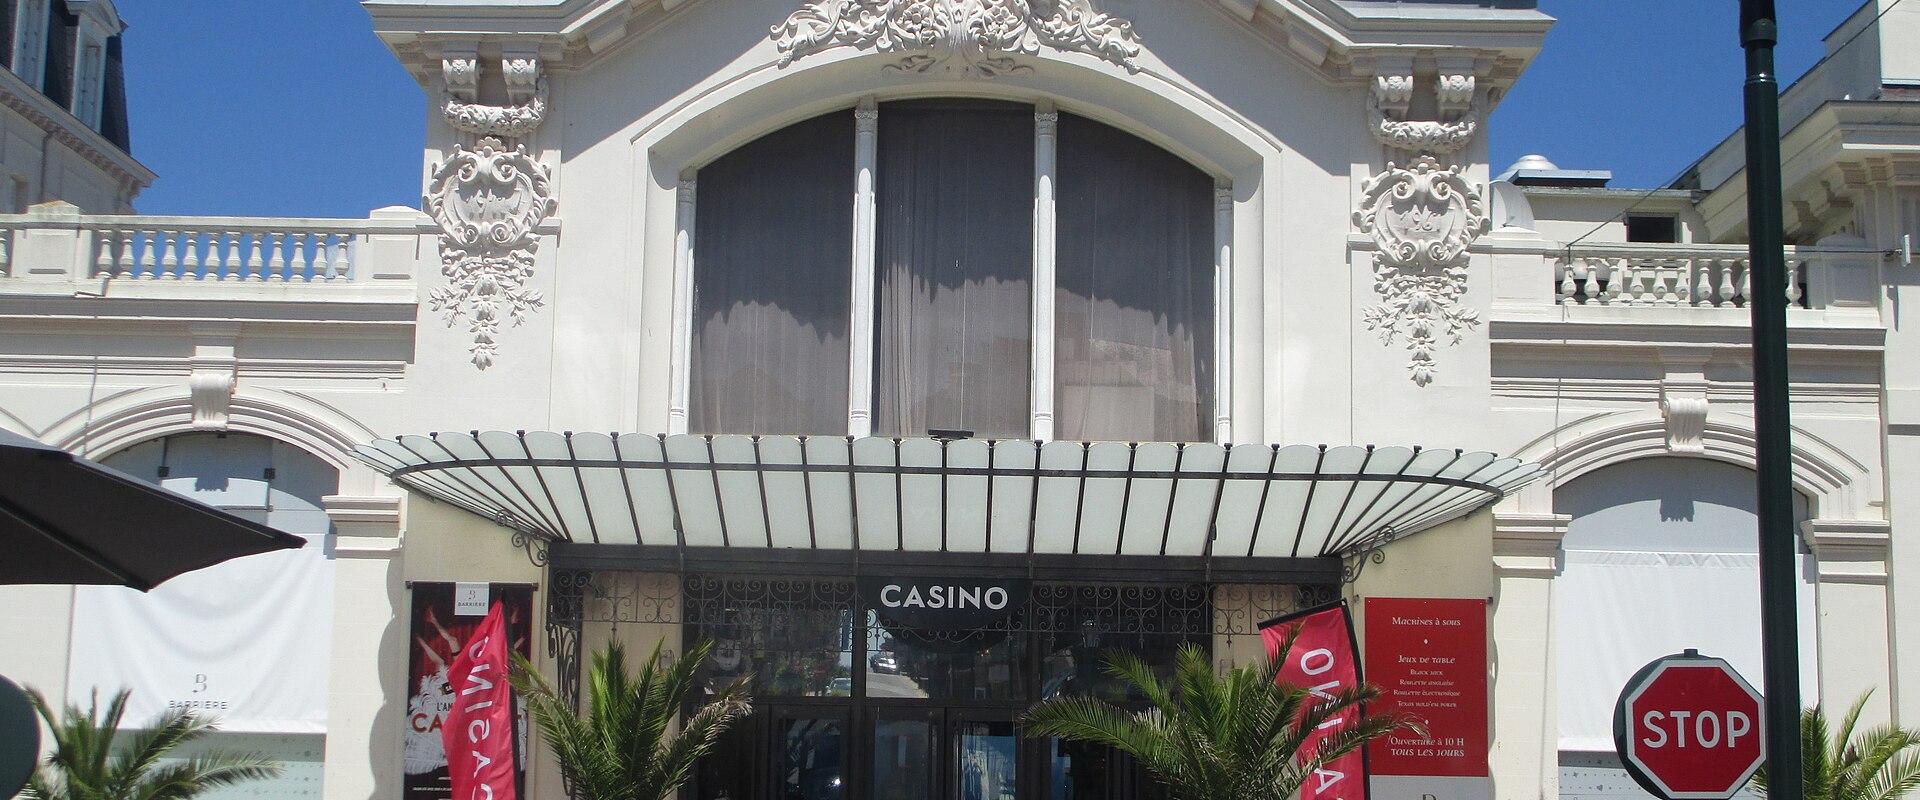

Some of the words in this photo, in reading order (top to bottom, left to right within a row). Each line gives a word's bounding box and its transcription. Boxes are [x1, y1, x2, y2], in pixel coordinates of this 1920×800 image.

[880, 584, 1009, 611] CASINO
[1445, 738, 1454, 746] 10
[1642, 710, 1751, 748] STOP
